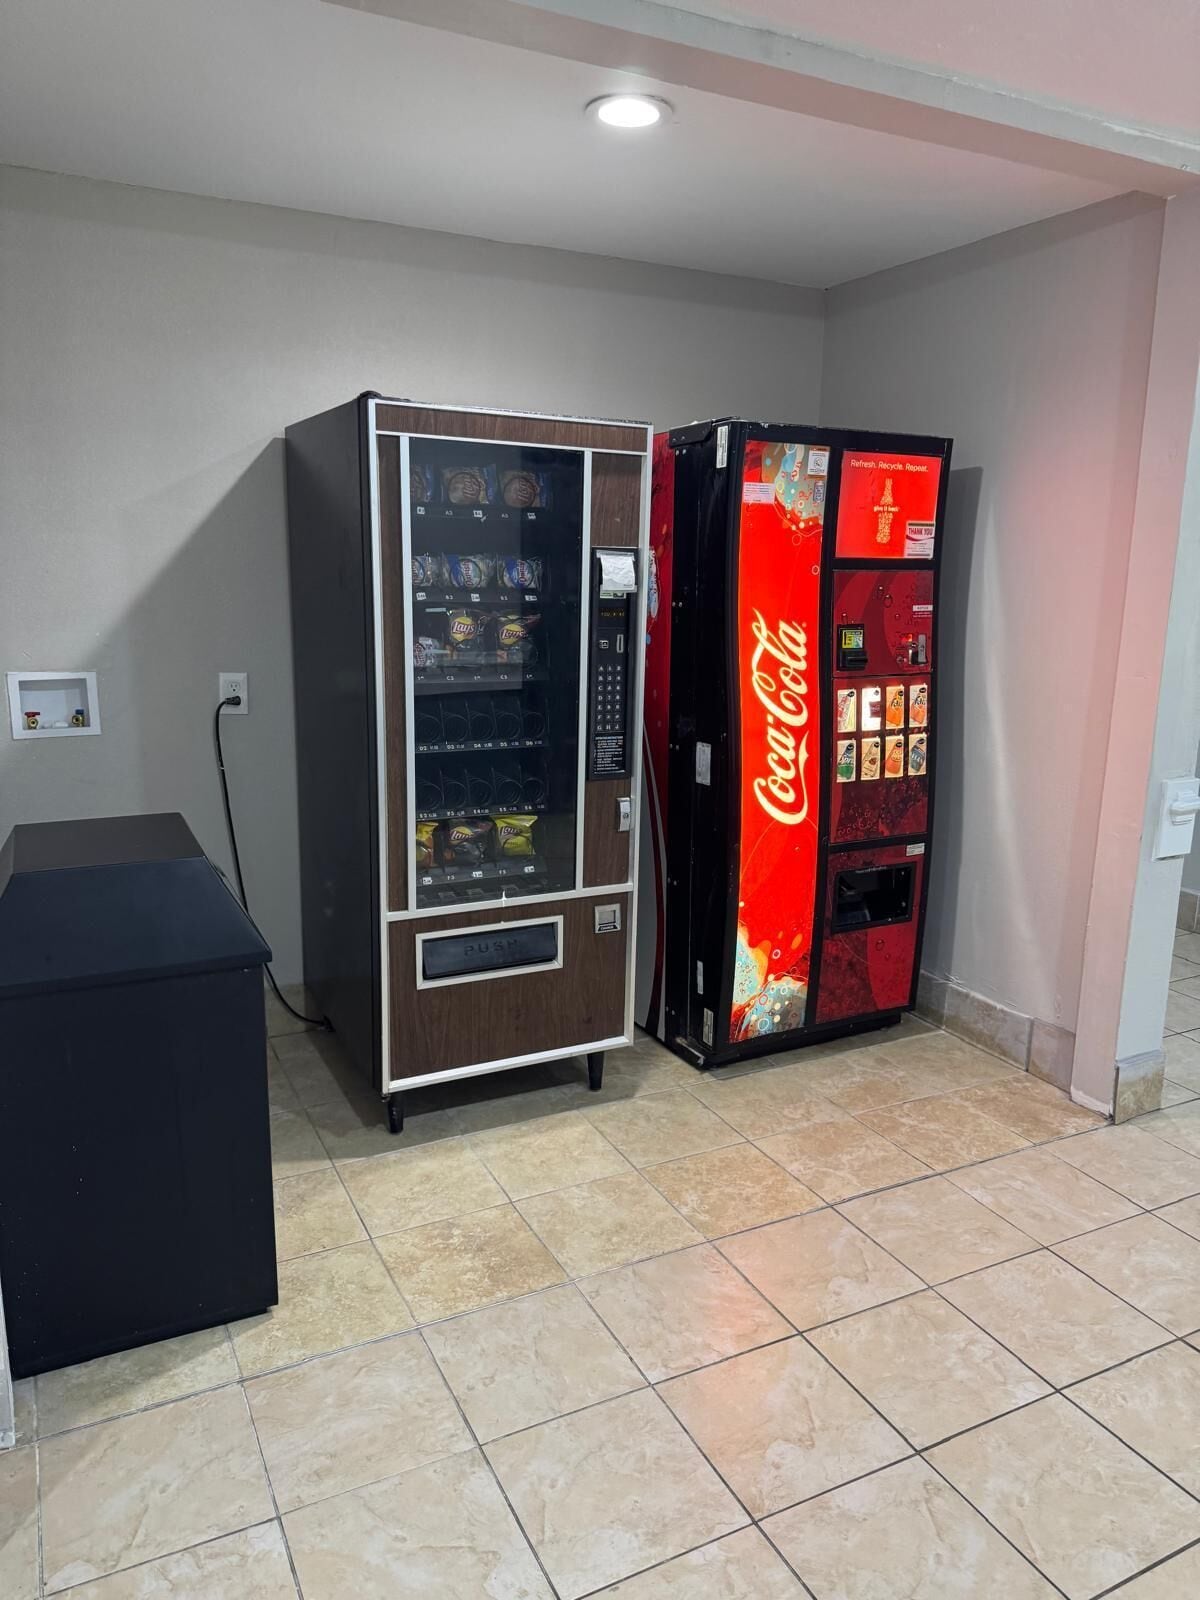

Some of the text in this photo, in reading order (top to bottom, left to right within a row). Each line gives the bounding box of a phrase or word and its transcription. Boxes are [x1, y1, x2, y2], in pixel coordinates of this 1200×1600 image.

[850, 459, 928, 472] Refresh. Recycle. Repeat.
[924, 528, 933, 536] YOU
[752, 607, 808, 824] Coca-Cola
[464, 938, 518, 957] PUSH
